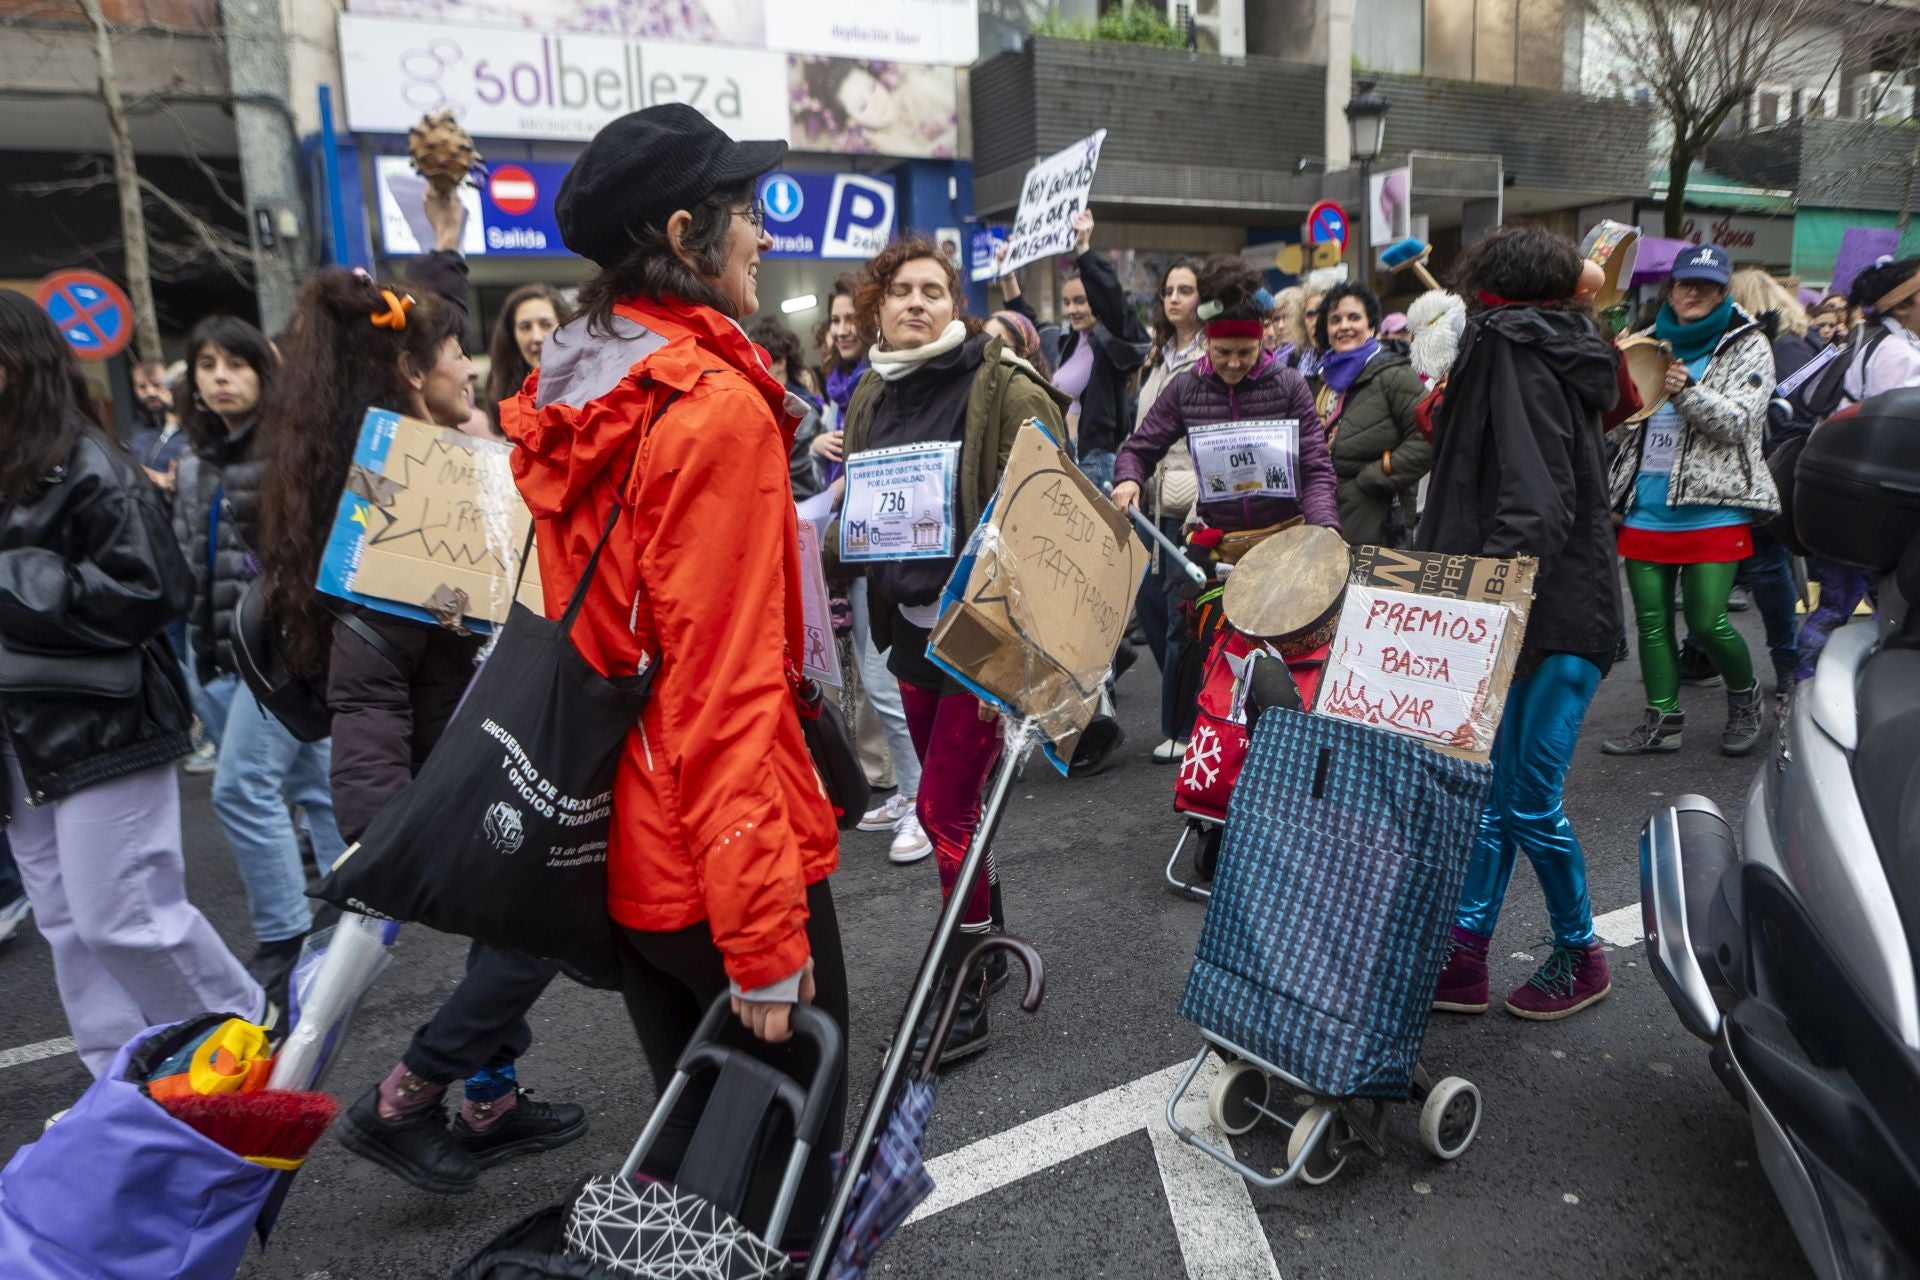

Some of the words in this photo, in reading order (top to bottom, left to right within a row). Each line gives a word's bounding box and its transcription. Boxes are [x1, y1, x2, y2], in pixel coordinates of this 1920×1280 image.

[474, 33, 743, 119] solbelleza
[1025, 171, 1050, 207] HOY
[833, 183, 886, 242] P
[487, 226, 547, 250] Salida
[1008, 240, 1028, 267] NO
[1650, 432, 1673, 448] 736
[1229, 451, 1257, 468] 041
[854, 469, 885, 480] CARRERA
[885, 466, 894, 477] DE
[867, 480, 881, 488] POR
[881, 478, 890, 487] LA
[890, 475, 926, 486] IGUALDAD
[879, 490, 906, 513] 736
[1040, 479, 1096, 543] ABAJO
[1381, 646, 1450, 682] BASTA
[501, 754, 513, 769] Y
[508, 767, 556, 818] OFICIOS
[558, 805, 612, 828] TRADICIO
[536, 778, 559, 801] DE
[546, 854, 593, 868] Jarandilla
[549, 845, 563, 856] 13
